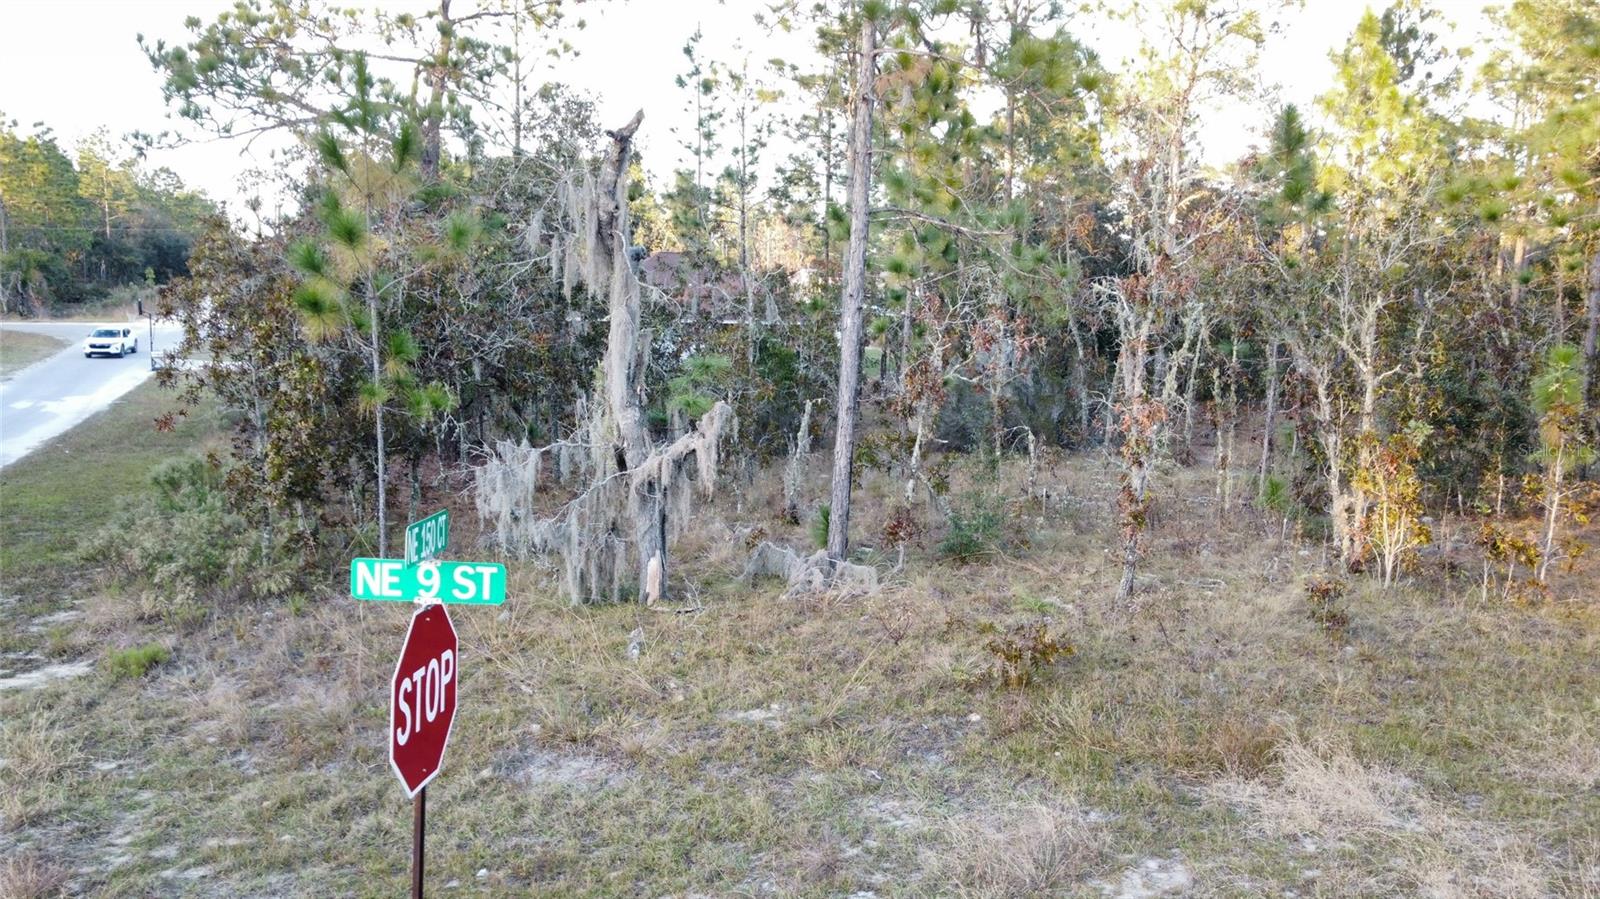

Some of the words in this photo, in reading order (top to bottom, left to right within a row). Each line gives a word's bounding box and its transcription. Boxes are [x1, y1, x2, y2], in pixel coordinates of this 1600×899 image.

[407, 527, 419, 565] NE
[421, 520, 436, 558] 150
[437, 515, 447, 548] CT
[356, 561, 403, 597] NE
[416, 562, 441, 598] 9
[452, 565, 498, 600] ST
[396, 648, 454, 746] STOP
